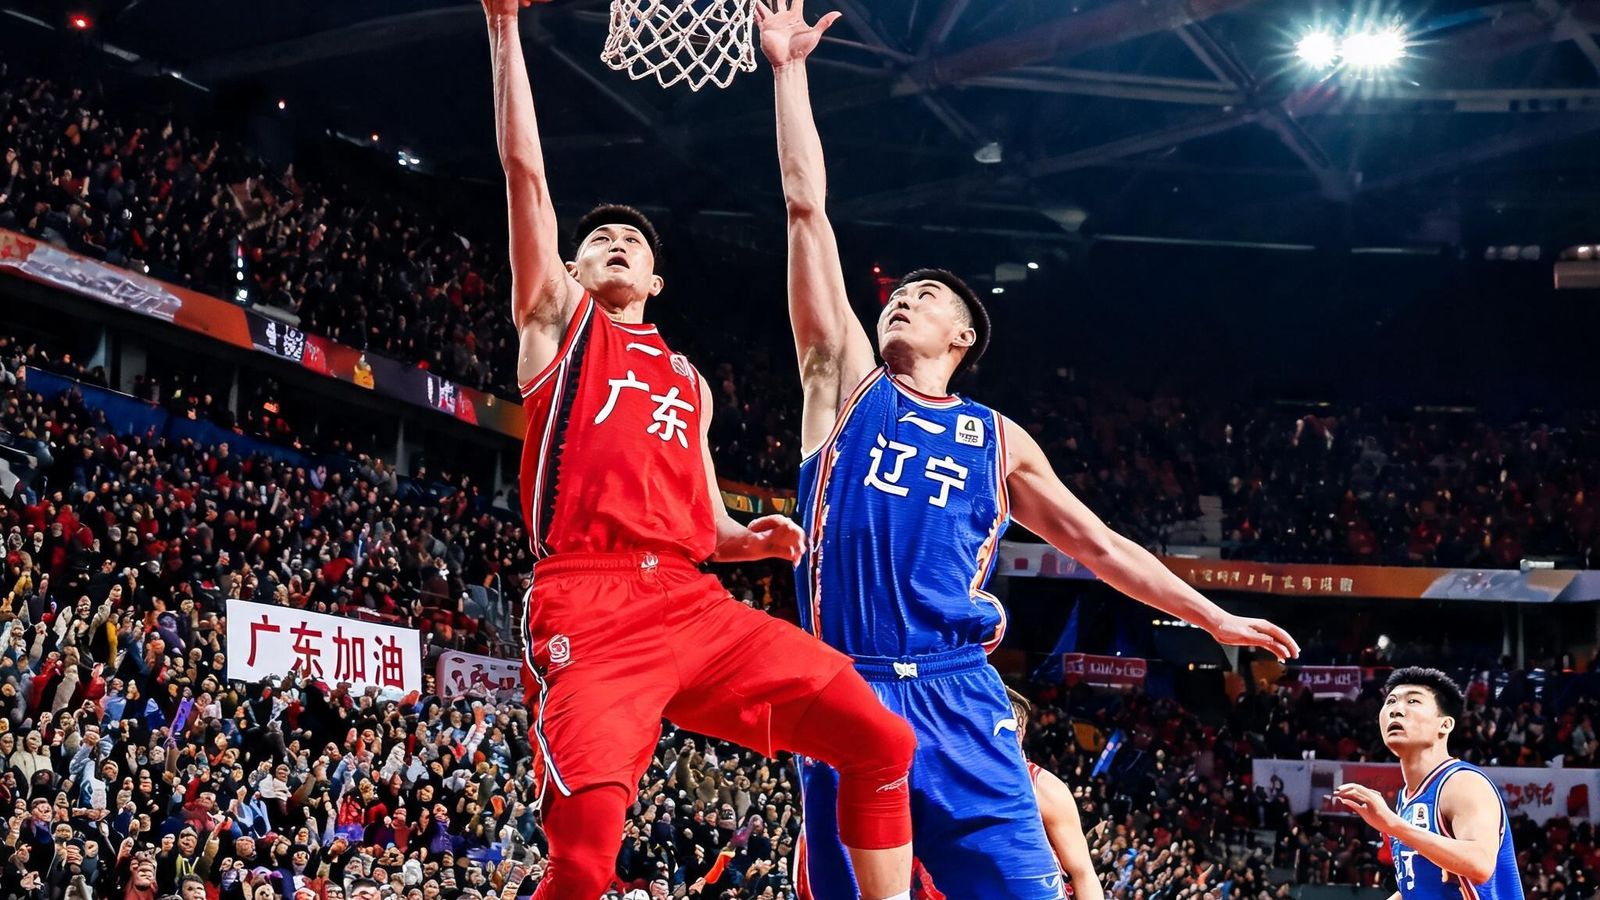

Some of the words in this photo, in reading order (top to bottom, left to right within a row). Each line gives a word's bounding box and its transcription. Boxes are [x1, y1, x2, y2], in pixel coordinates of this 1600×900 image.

[594, 370, 695, 449] 广东
[864, 432, 969, 508] 辽宁
[247, 614, 405, 691] 广东加油
